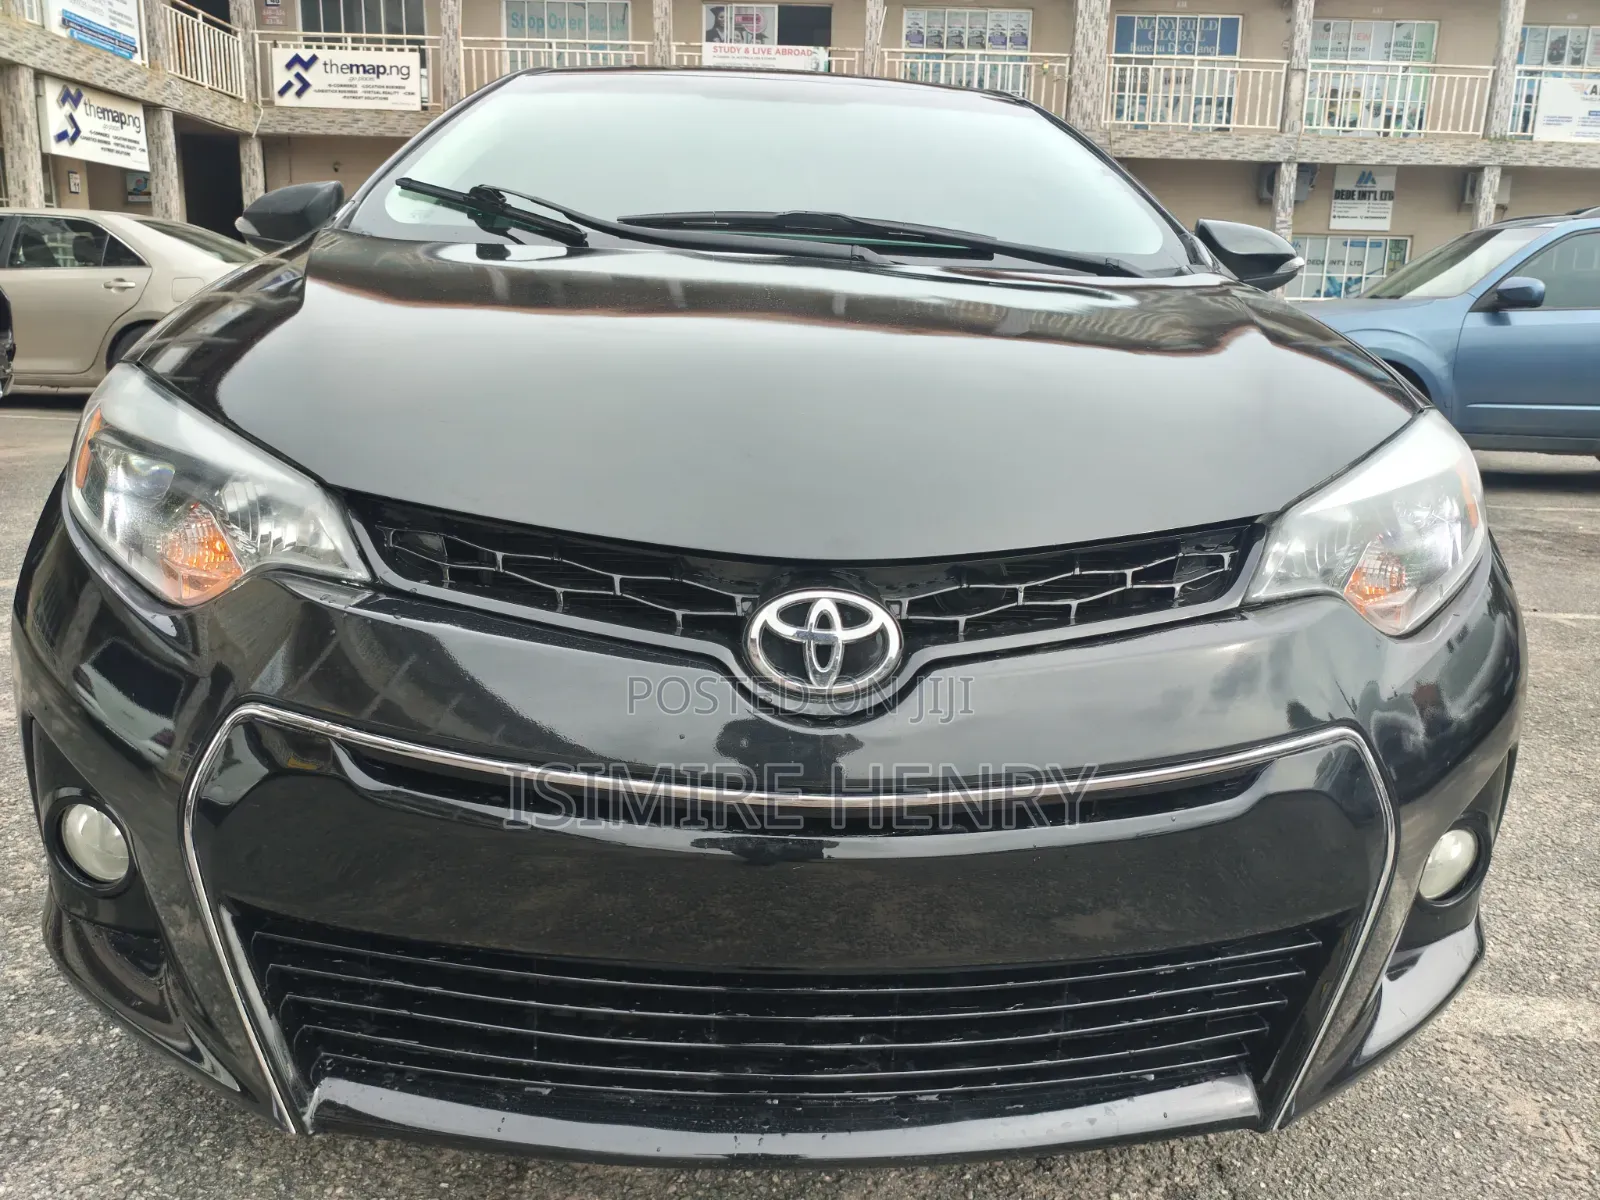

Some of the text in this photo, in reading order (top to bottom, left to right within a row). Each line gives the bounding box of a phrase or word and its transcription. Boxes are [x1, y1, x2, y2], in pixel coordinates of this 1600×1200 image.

[511, 11, 545, 33] Stop
[549, 12, 583, 30] Over
[1148, 30, 1206, 41] GLOBAL
[713, 46, 741, 54] STUDY
[775, 48, 813, 57] ABROAD
[323, 58, 410, 80] themap.ng
[84, 98, 141, 134] themap.ng
[1334, 189, 1356, 201] DEDE
[1380, 190, 1394, 201] LTD
